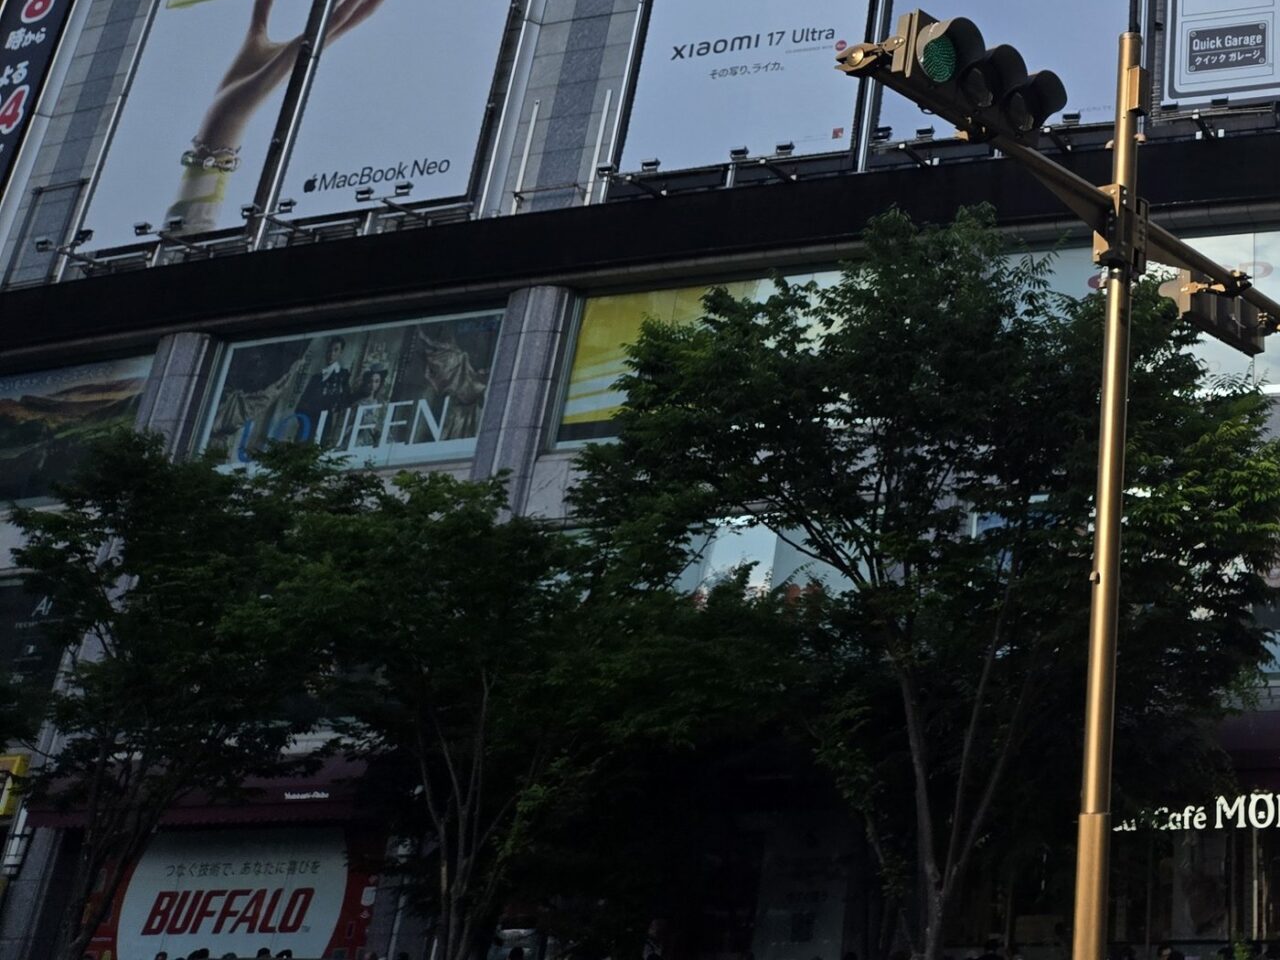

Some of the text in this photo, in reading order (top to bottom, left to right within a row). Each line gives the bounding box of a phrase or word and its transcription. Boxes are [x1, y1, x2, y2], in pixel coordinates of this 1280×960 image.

[767, 31, 786, 46] 17
[792, 27, 835, 44] Ultra
[1192, 34, 1262, 51] Quick Garage
[318, 158, 450, 191] MacBook Neo
[141, 887, 315, 936] BUFFALO
